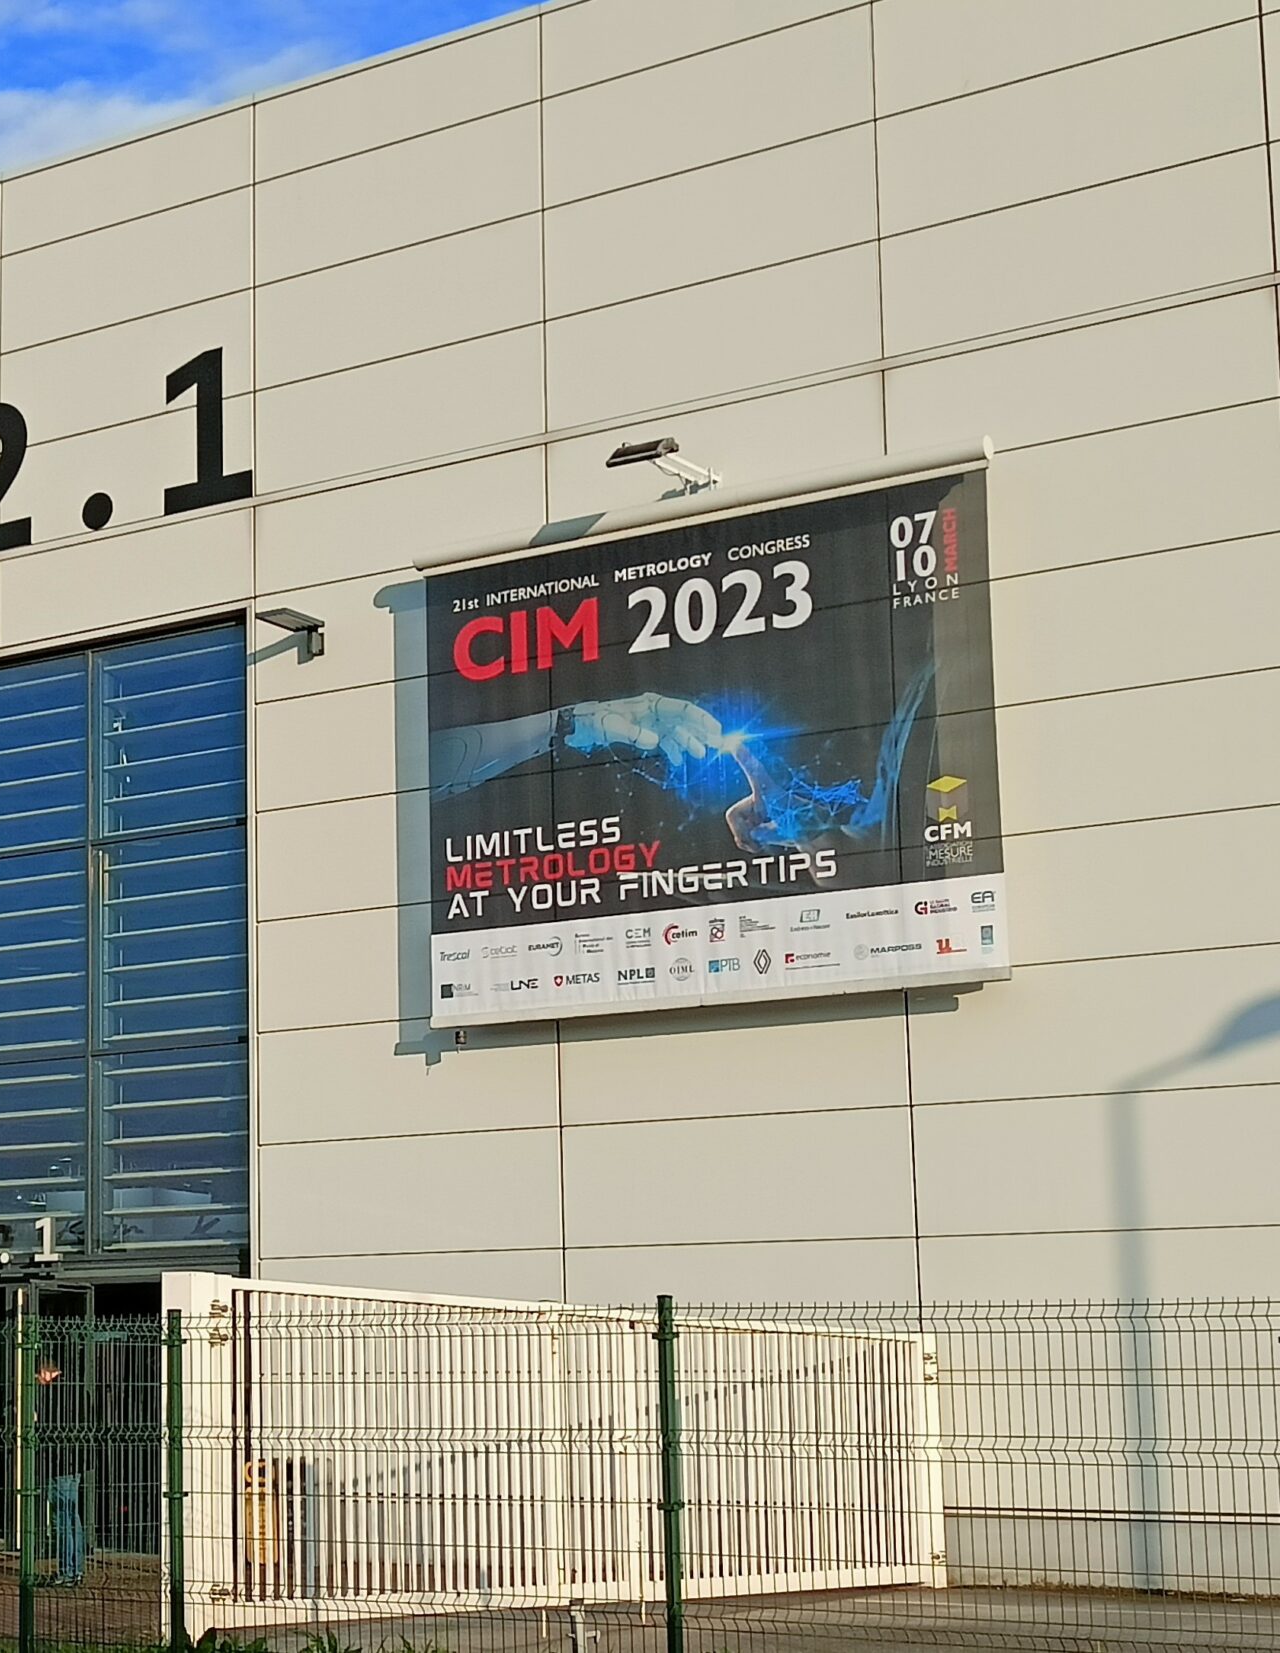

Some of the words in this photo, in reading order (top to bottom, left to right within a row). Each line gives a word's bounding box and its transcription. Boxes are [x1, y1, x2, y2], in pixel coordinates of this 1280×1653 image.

[890, 510, 937, 549] 07
[942, 507, 958, 574] MARCH
[452, 598, 480, 613] 21st
[486, 574, 600, 607] INTERNATIONAL
[614, 552, 712, 582] METROLOGY
[727, 534, 811, 561] CONGRESS
[896, 544, 937, 581] 10
[892, 572, 959, 596] LYON
[893, 587, 960, 609] FRANCE
[453, 597, 599, 681] CIM
[628, 560, 813, 654] 2023
[446, 816, 621, 862] LIMITLESS
[924, 821, 972, 842] CFM
[928, 845, 973, 860] MESURE
[446, 840, 660, 891] METROLOGY
[447, 890, 489, 919] AT
[507, 877, 601, 912] YOUR
[618, 849, 837, 900] FINGERTIPS
[971, 890, 995, 904] EA
[625, 927, 651, 939] CEM
[671, 928, 698, 939] cetim
[870, 943, 922, 954] MARPOSS
[617, 969, 644, 981] NPL
[720, 957, 741, 972] PTB
[566, 973, 600, 985] METAS
